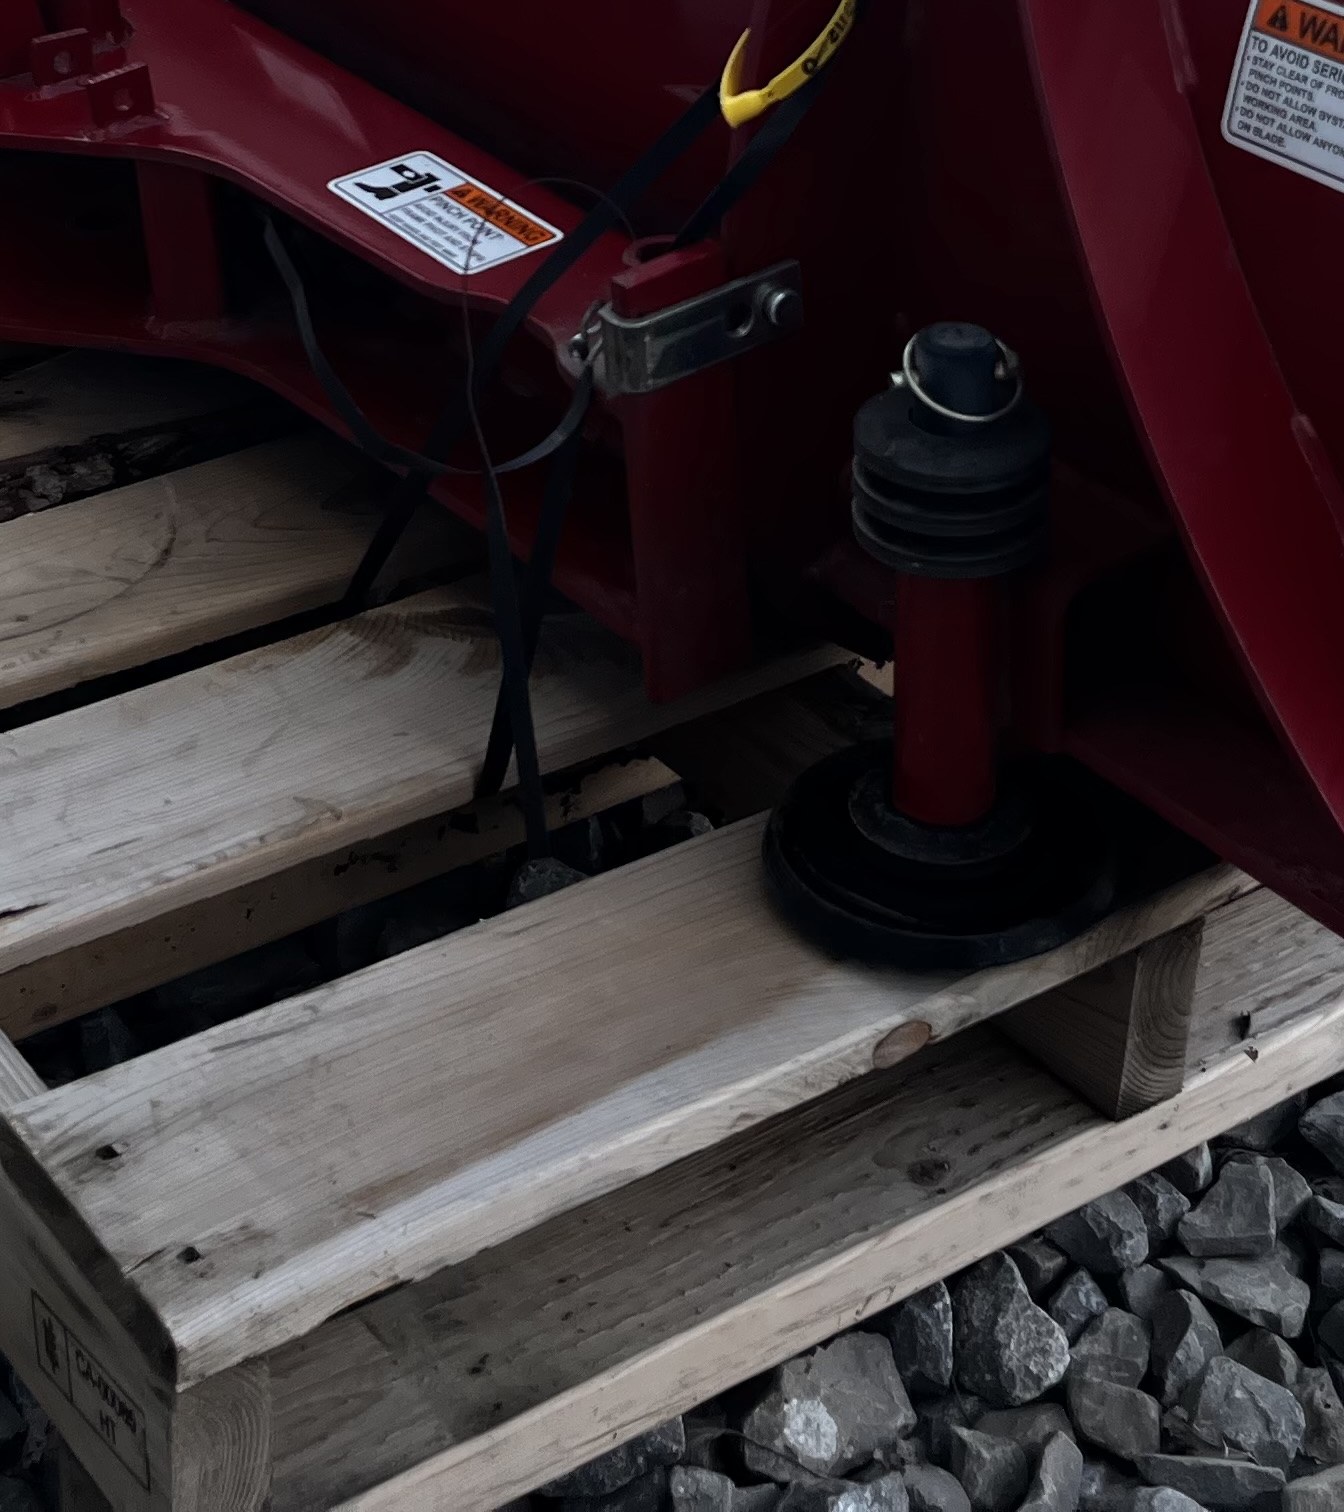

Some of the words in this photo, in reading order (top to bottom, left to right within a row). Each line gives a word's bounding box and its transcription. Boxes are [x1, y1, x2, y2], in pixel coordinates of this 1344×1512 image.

[1250, 35, 1269, 54] TO
[1270, 44, 1310, 70] AVOID
[1248, 69, 1277, 88] PINCH
[1252, 56, 1274, 72] STAY
[1276, 66, 1308, 86] CLEAR
[1310, 79, 1322, 91] OF
[1244, 95, 1288, 120] WORKING
[1246, 82, 1260, 94] DO
[1261, 88, 1281, 103] NOT
[1283, 97, 1317, 118] ALLOW
[1238, 120, 1252, 133] ON
[1241, 107, 1254, 120] DO
[1256, 114, 1275, 129] NOT
[1277, 122, 1312, 144] ALLOW
[430, 195, 470, 220] PINCH
